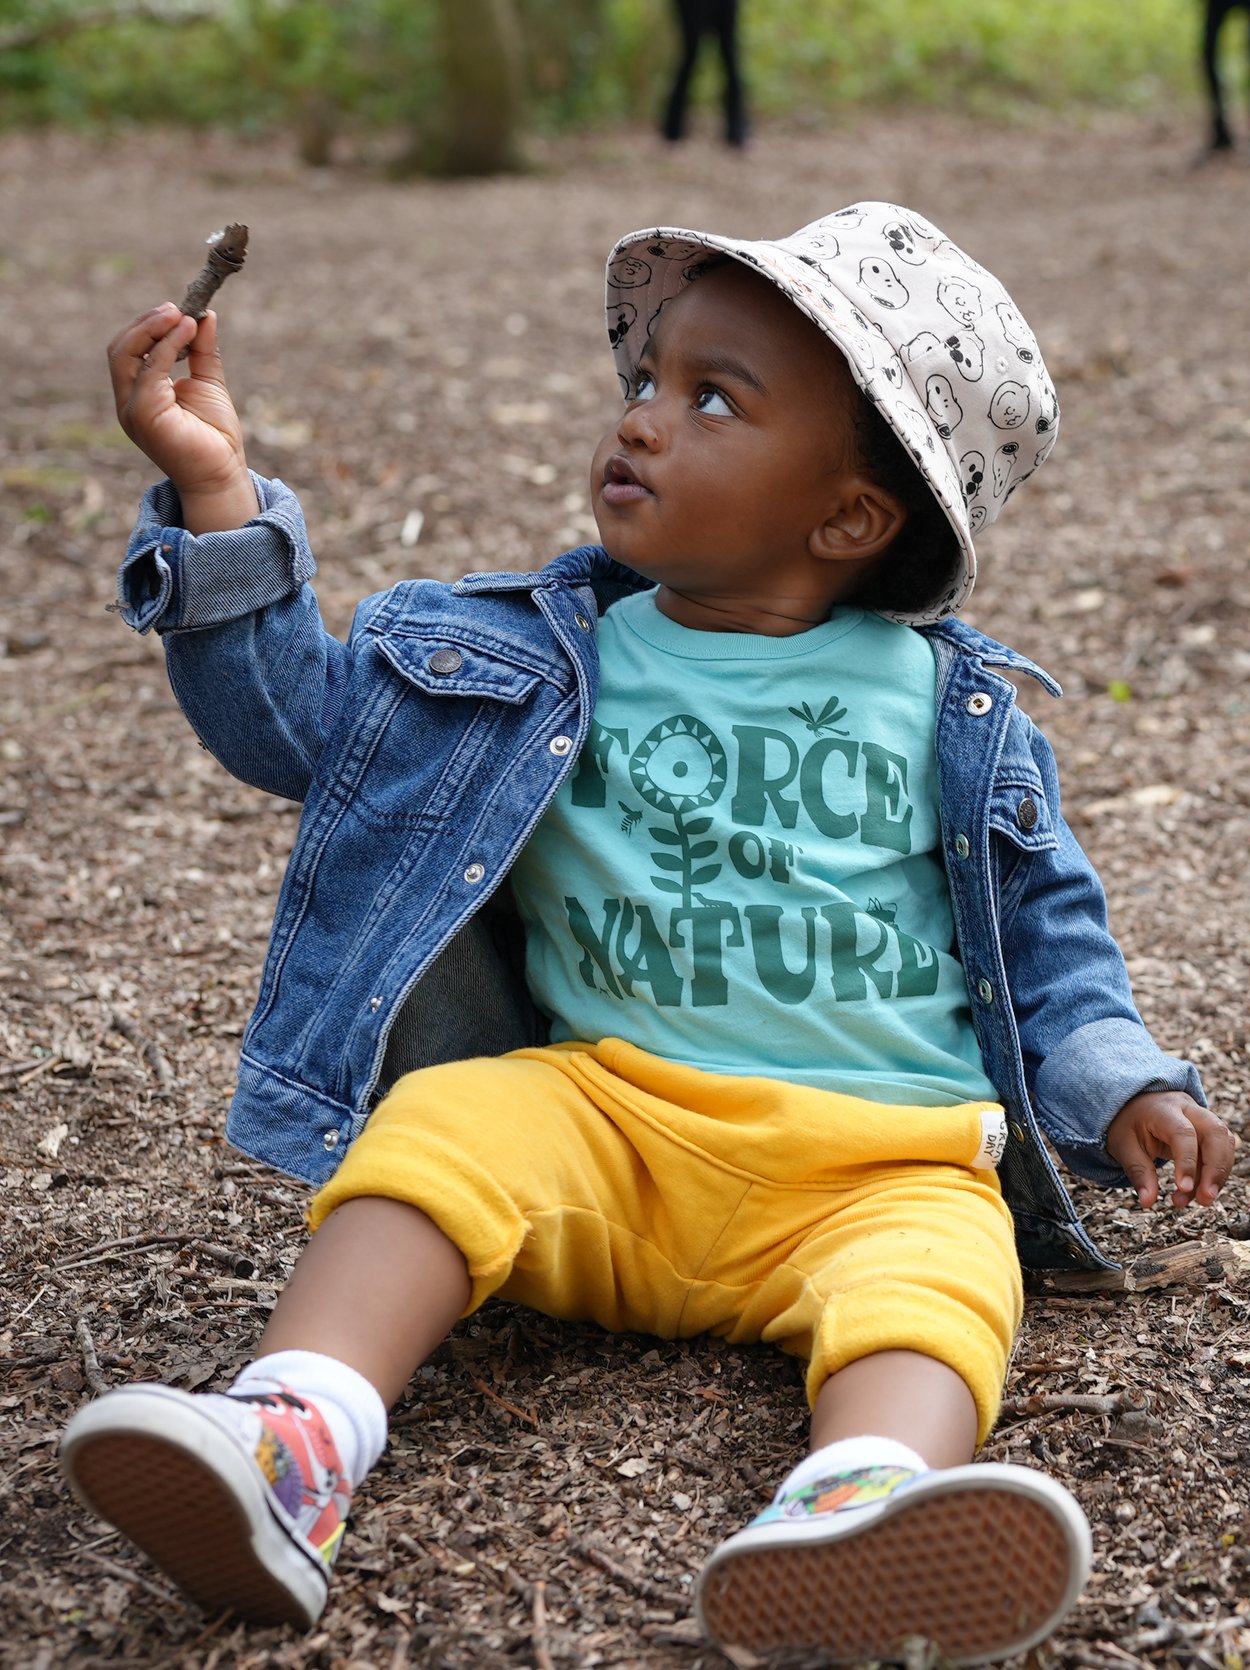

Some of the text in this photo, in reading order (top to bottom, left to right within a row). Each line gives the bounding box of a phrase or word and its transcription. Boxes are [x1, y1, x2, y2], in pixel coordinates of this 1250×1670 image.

[571, 715, 912, 854] FORCE
[728, 830, 804, 885] OF
[984, 1134, 997, 1157] DAY
